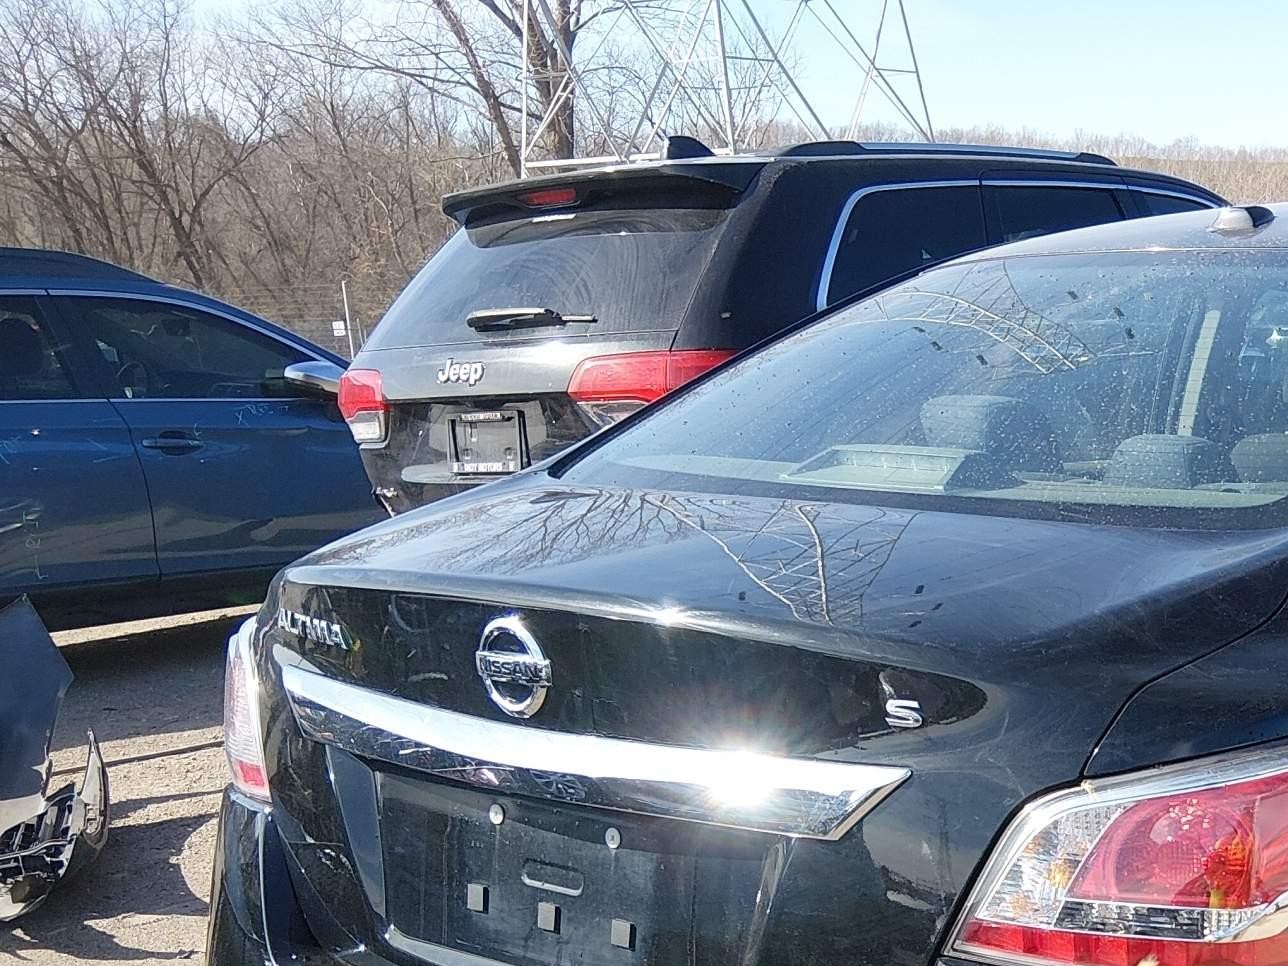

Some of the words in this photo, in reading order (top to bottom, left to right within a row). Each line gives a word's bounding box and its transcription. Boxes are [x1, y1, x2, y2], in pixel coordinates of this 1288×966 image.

[437, 357, 484, 387] Jeep
[278, 608, 348, 649] ALTIMA
[480, 657, 541, 679] NISSAN
[885, 699, 922, 728] S
